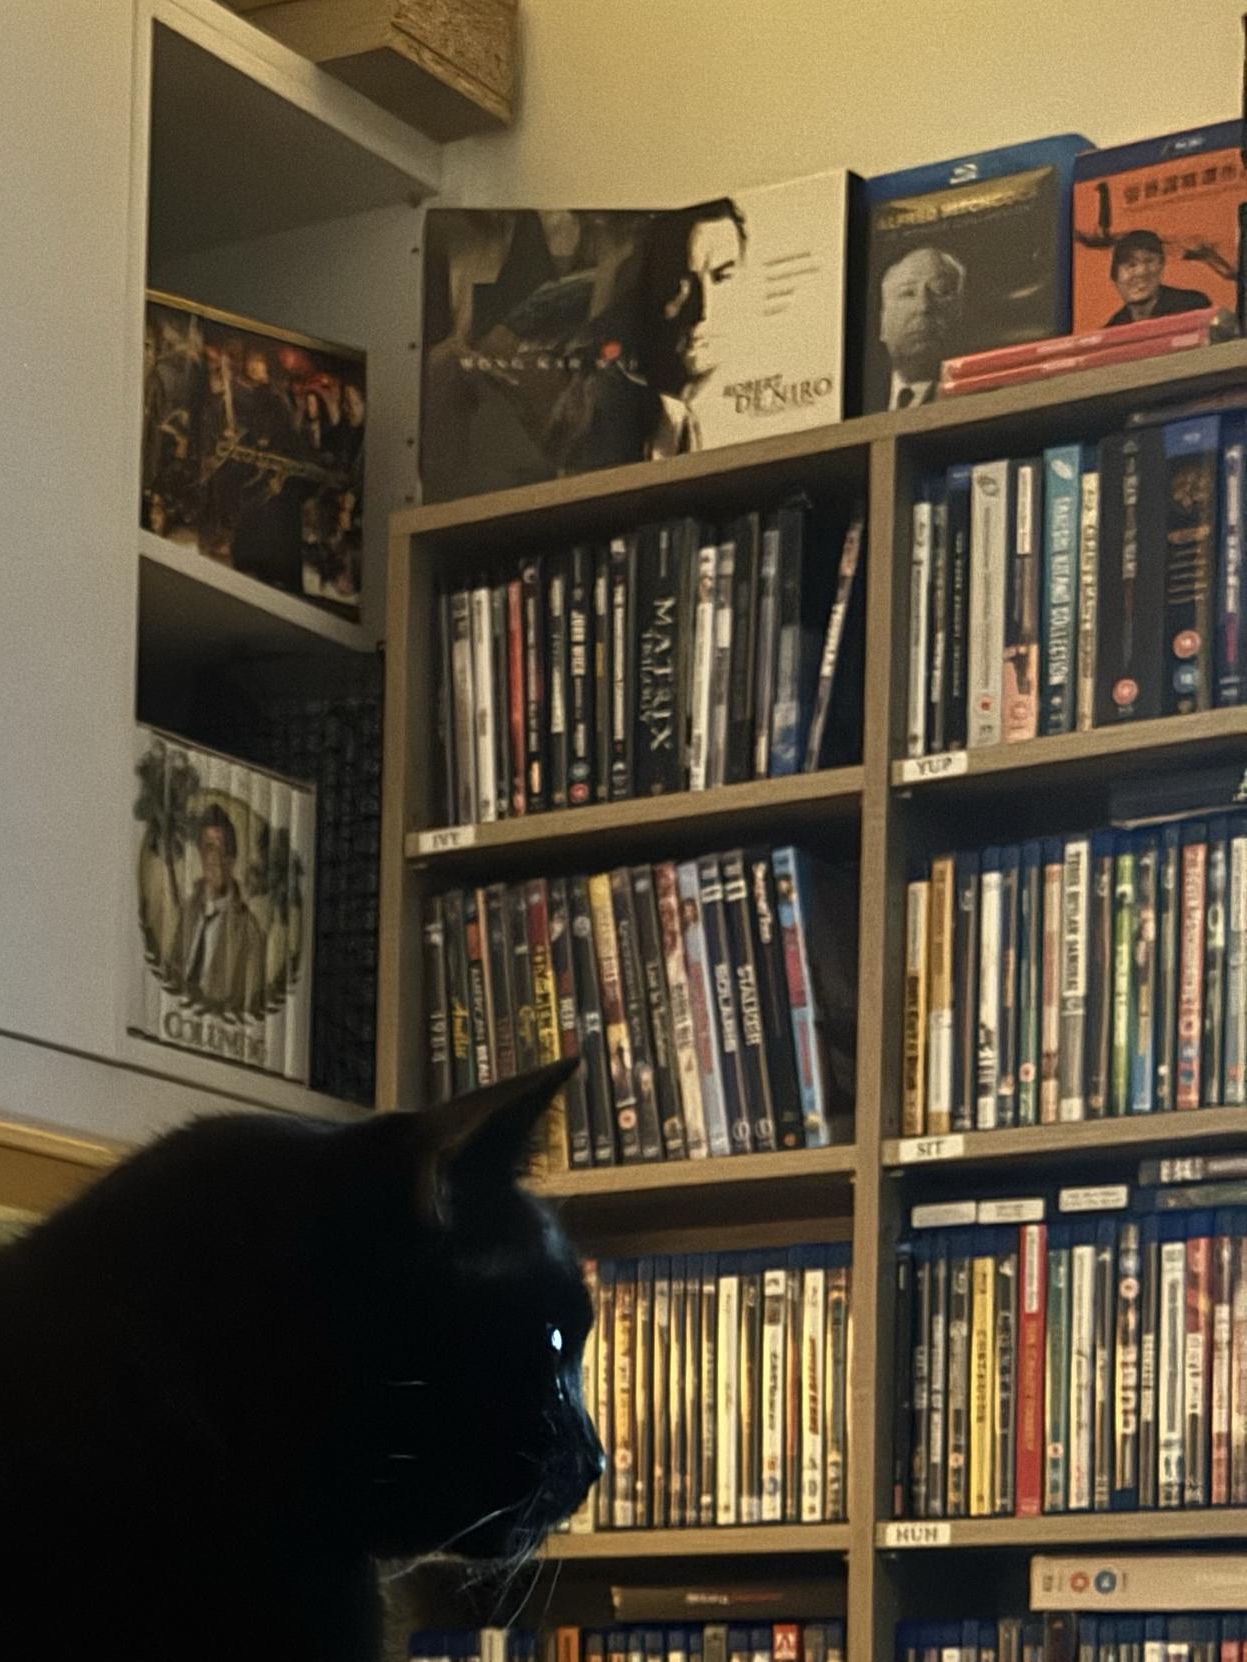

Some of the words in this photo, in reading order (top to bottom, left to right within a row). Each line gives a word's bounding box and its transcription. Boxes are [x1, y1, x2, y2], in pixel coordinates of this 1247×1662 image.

[570, 610, 587, 642] JOHN
[1048, 605, 1071, 686] COLLECTION
[571, 645, 588, 677] WICK
[649, 596, 676, 751] MATRIX
[916, 756, 953, 775] YUP
[737, 964, 761, 1047] STALKER
[431, 1011, 447, 1064] 1984
[916, 1140, 944, 1157] SIT
